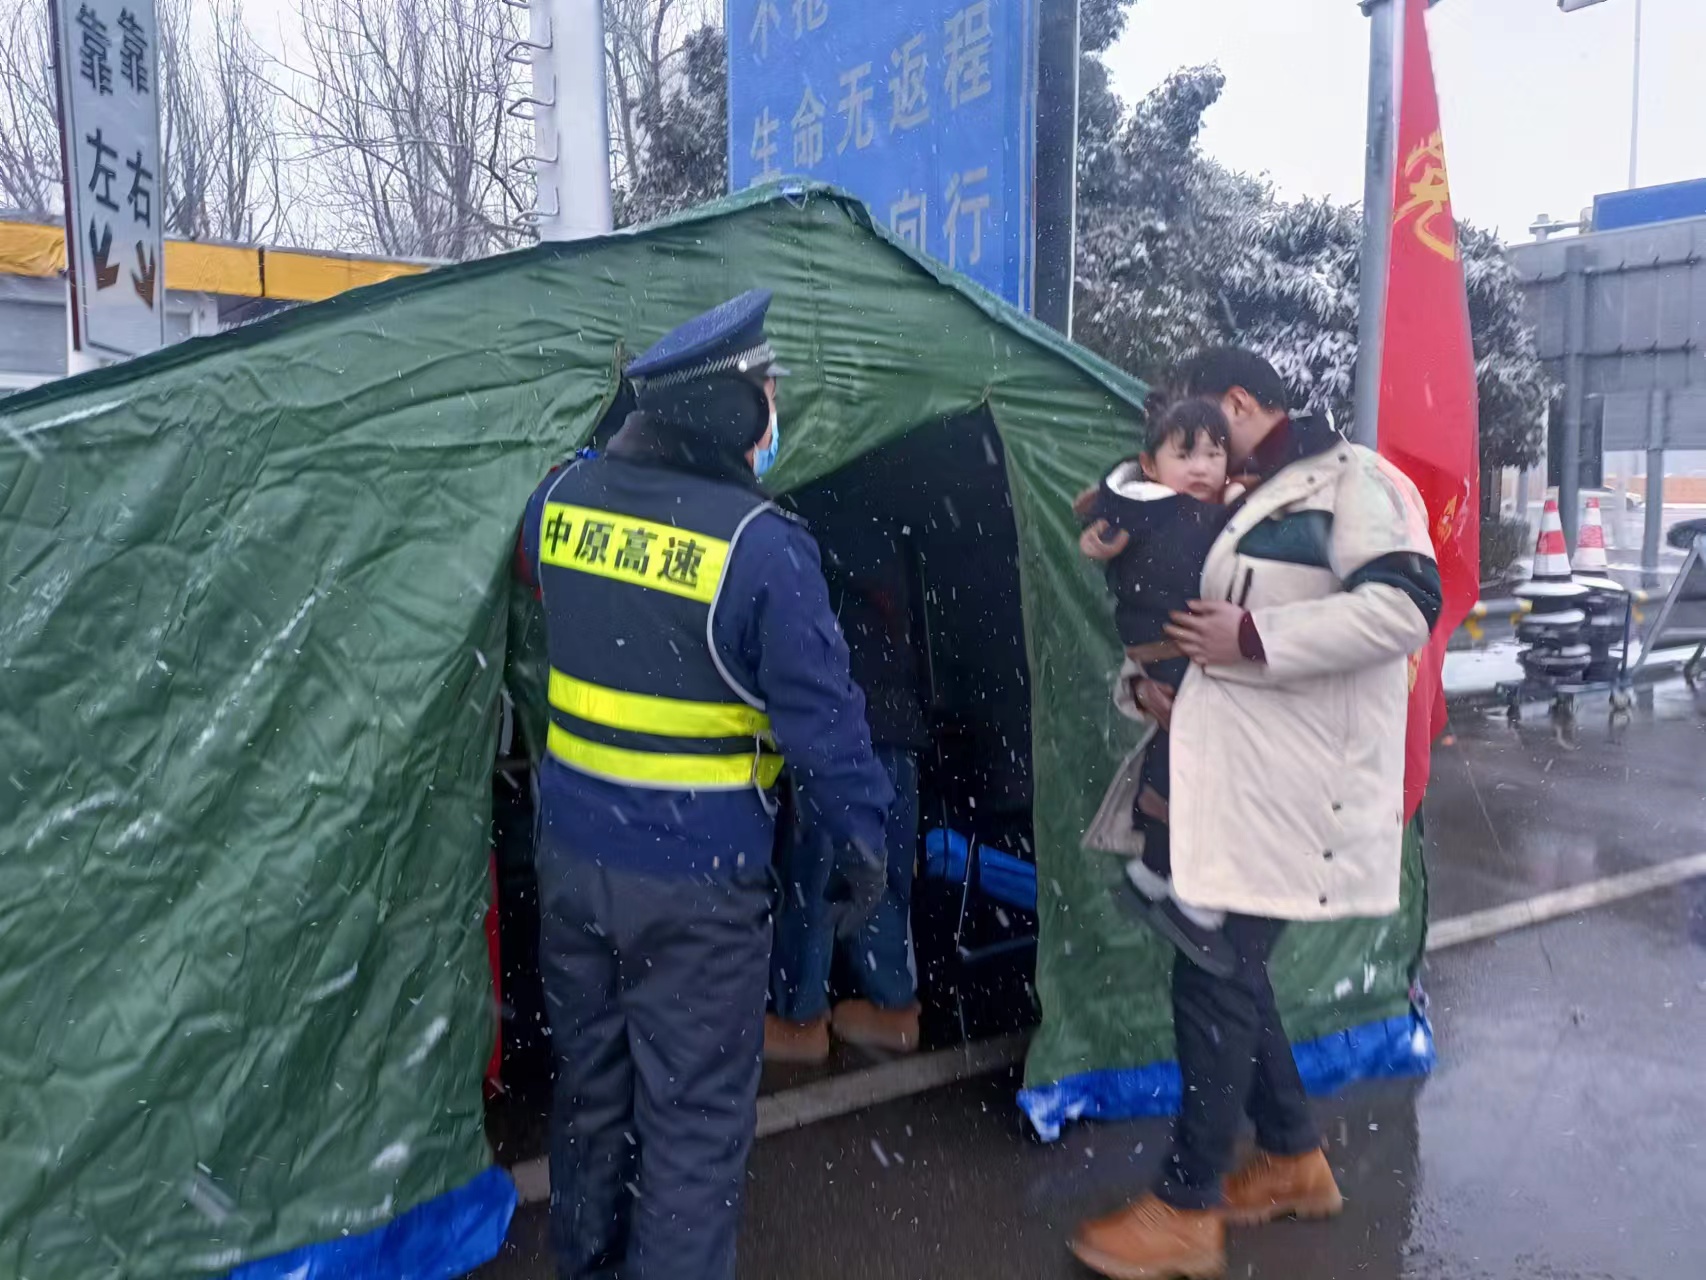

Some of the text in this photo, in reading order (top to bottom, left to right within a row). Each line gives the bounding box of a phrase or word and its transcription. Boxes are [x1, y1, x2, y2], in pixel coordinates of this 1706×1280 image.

[750, 1, 992, 185] 生命无返程
[545, 510, 706, 588] 中原高速
